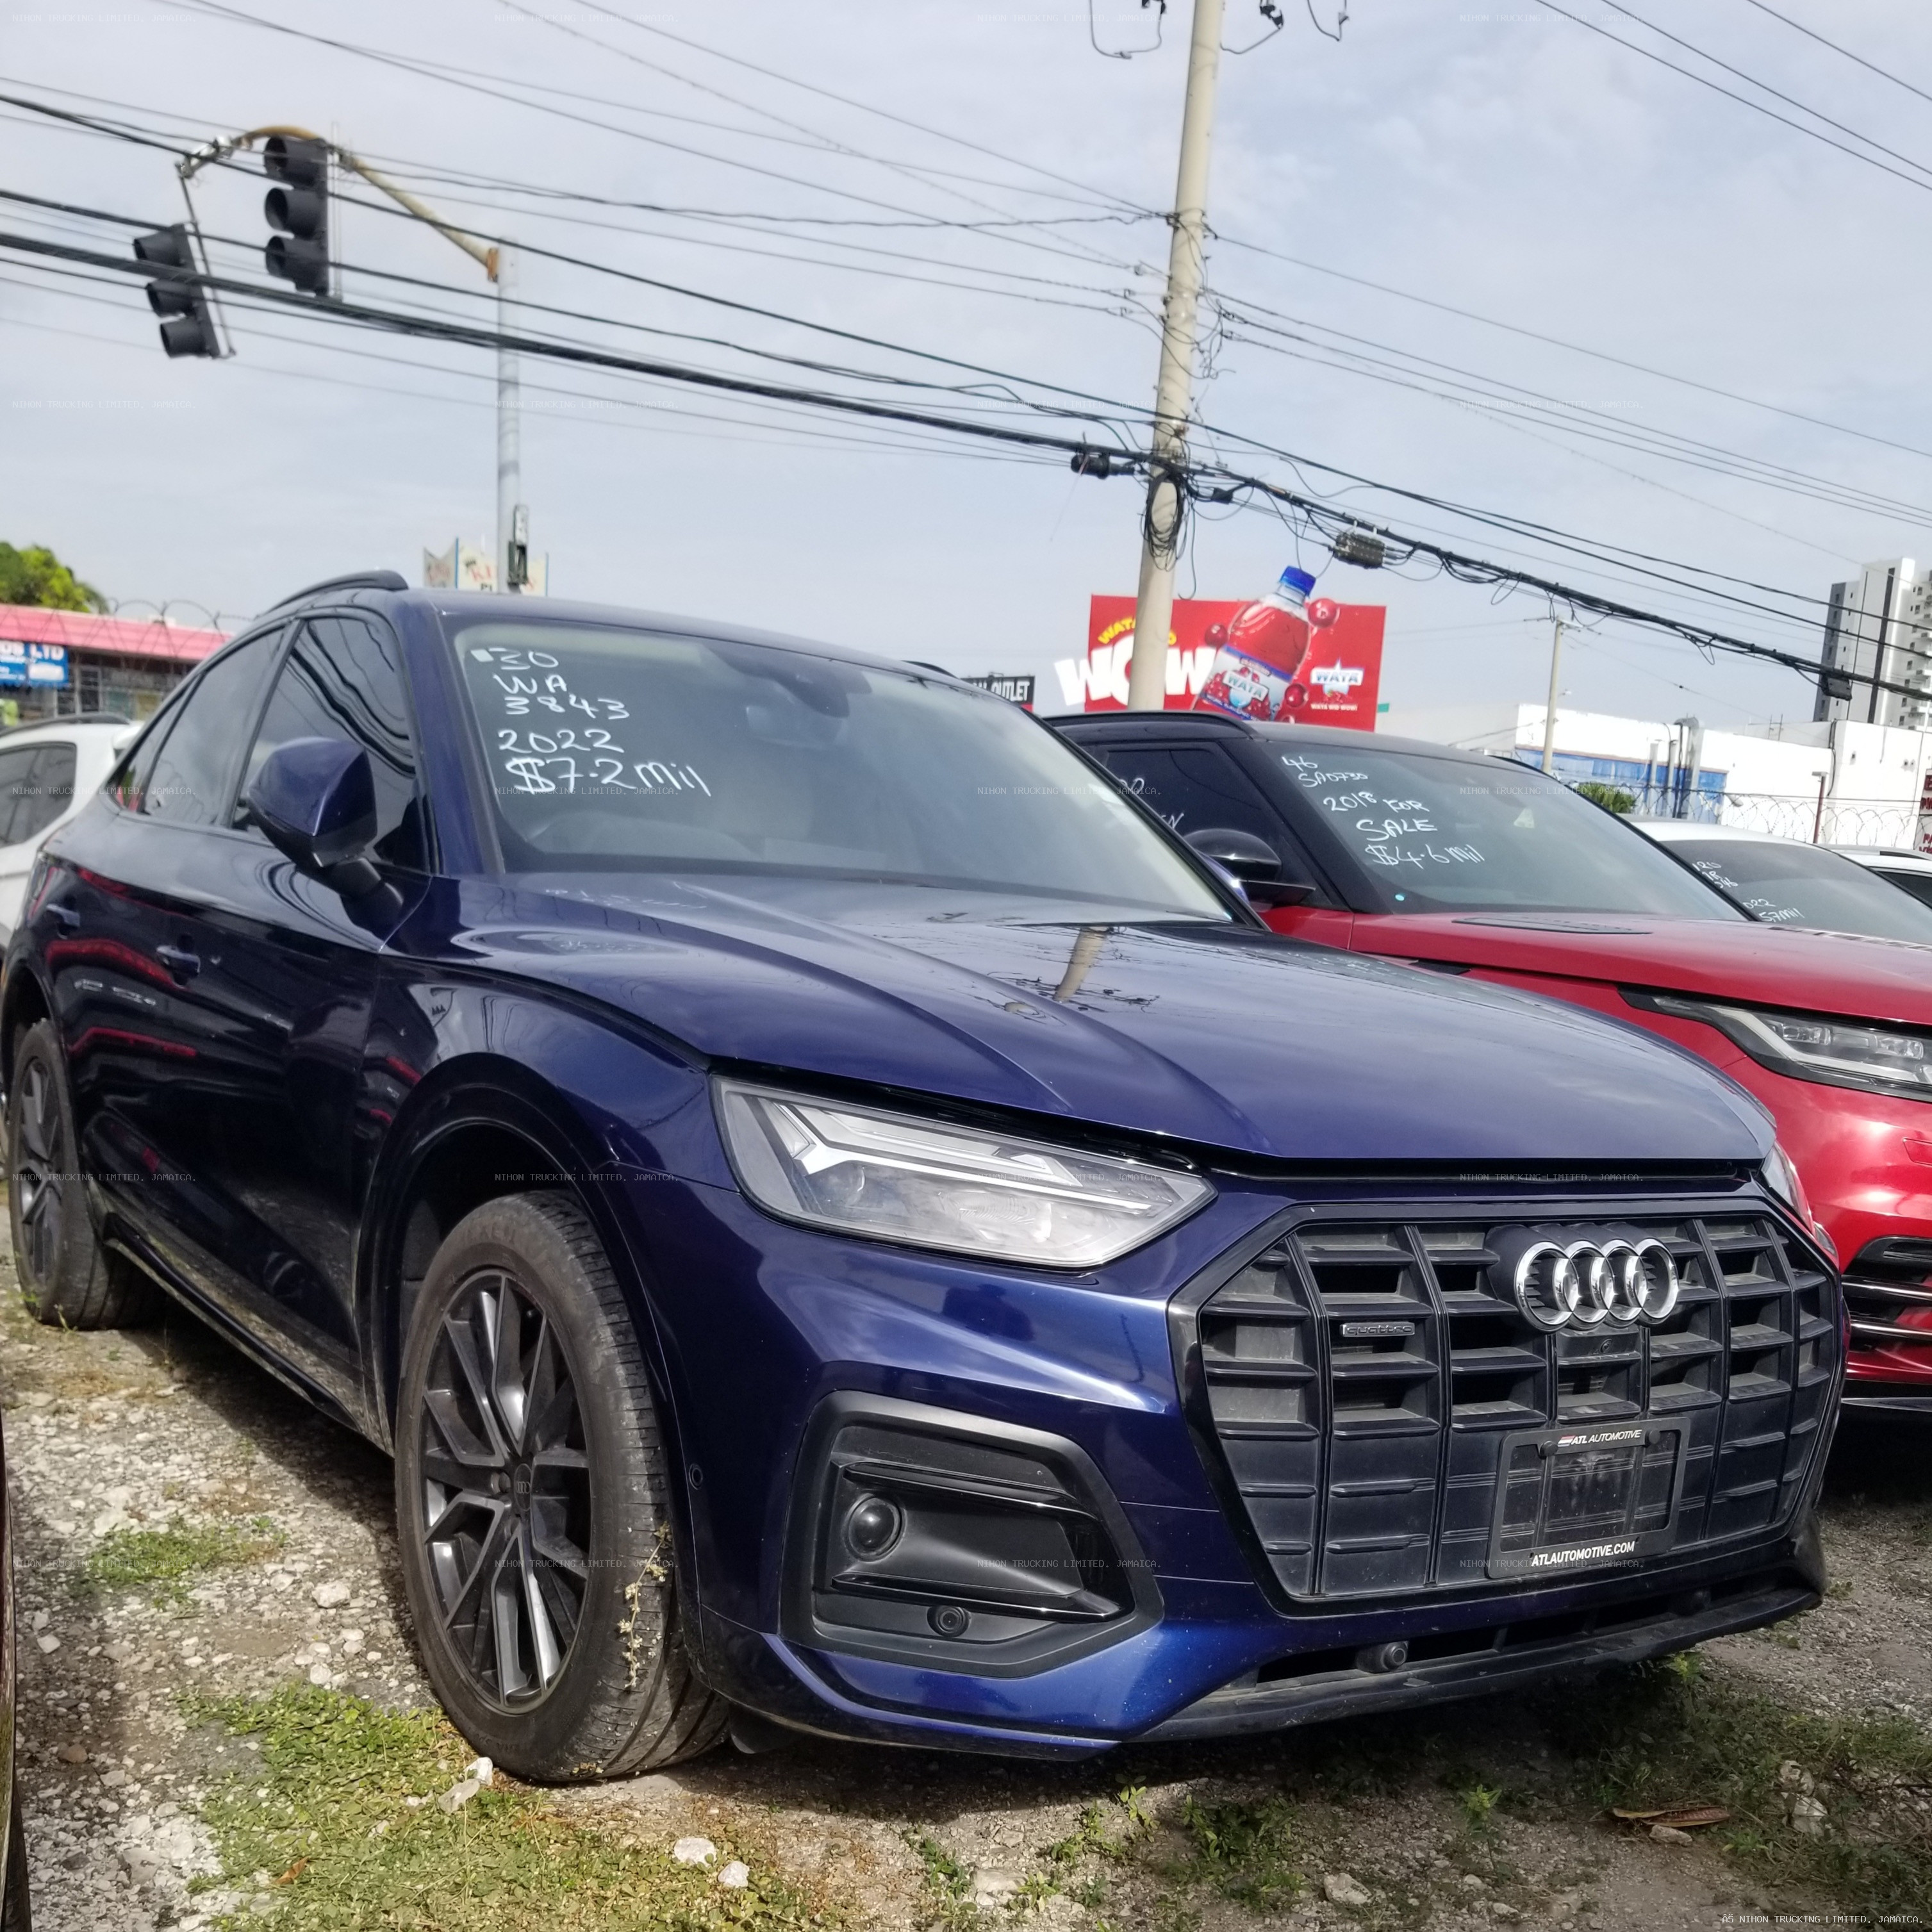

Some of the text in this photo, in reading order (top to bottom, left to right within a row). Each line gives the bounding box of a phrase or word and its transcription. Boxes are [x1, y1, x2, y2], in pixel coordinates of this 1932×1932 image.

[29, 643, 64, 660] LTD
[1228, 675, 1263, 698] WATA
[504, 693, 631, 720] 3843
[497, 729, 625, 754] 2022
[1282, 756, 1318, 772] 46
[1323, 791, 1430, 813] 2018 FOR
[1356, 819, 1438, 841] SALE
[1346, 1325, 1412, 1335] quattro
[1571, 1430, 1642, 1445] ATL AUTOMOTIVE
[1531, 1540, 1635, 1567] ATLAUTOMOTIVE.COM
